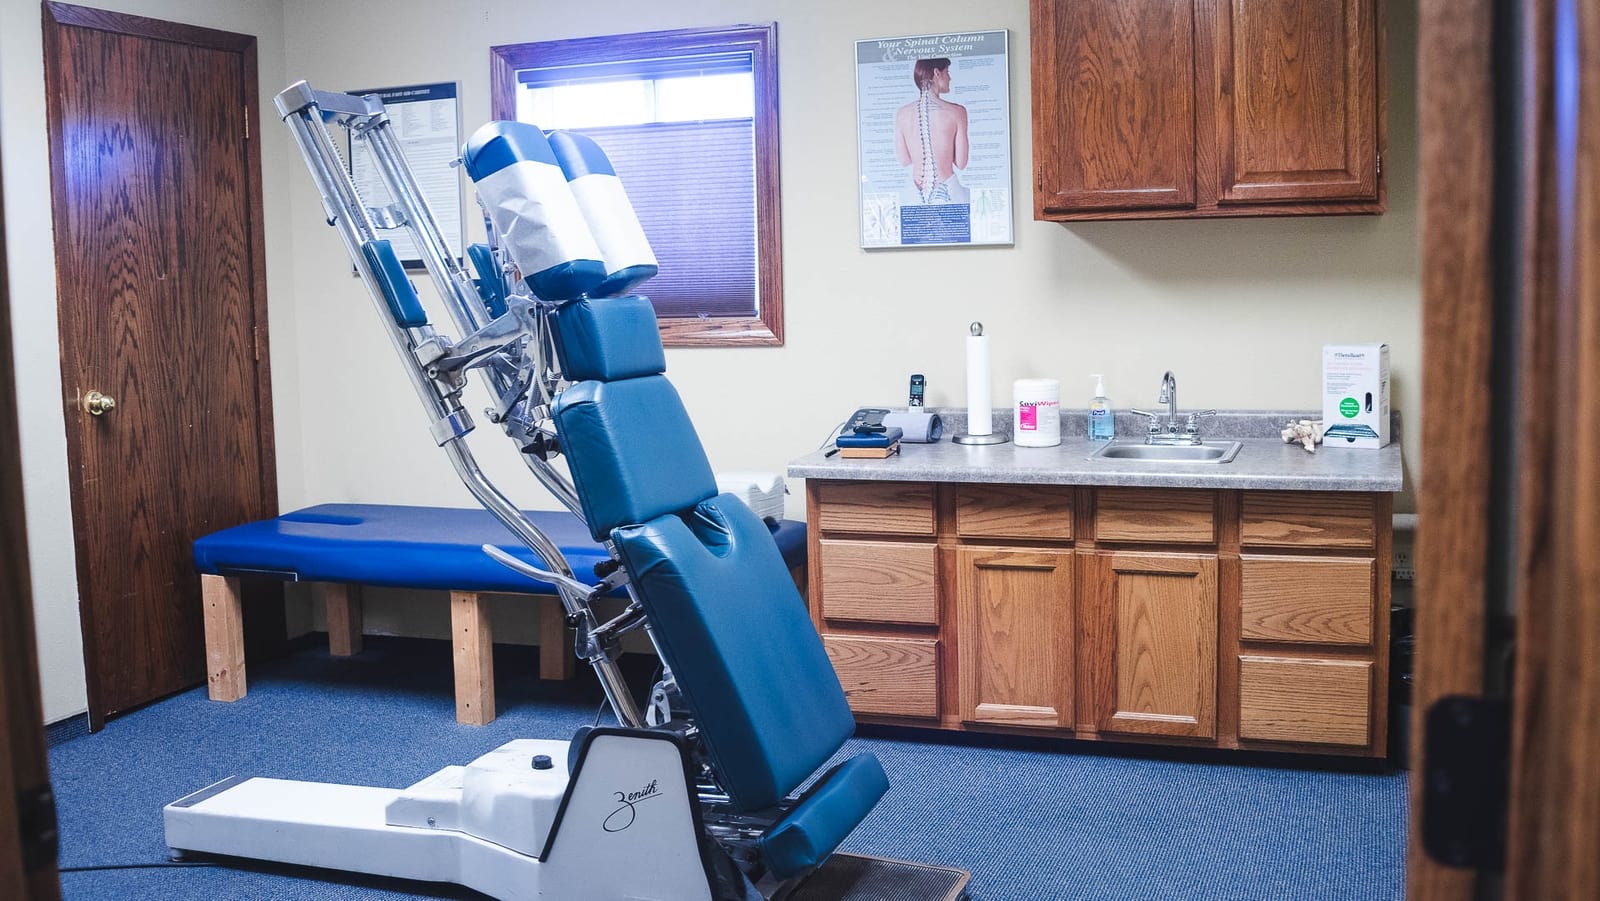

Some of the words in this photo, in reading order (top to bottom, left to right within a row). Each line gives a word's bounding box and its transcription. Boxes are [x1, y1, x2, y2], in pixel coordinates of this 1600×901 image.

[878, 41, 901, 49] Your
[904, 37, 938, 48] Spinal
[942, 34, 984, 44] Column
[896, 47, 935, 55] Nervous
[939, 44, 973, 53] System
